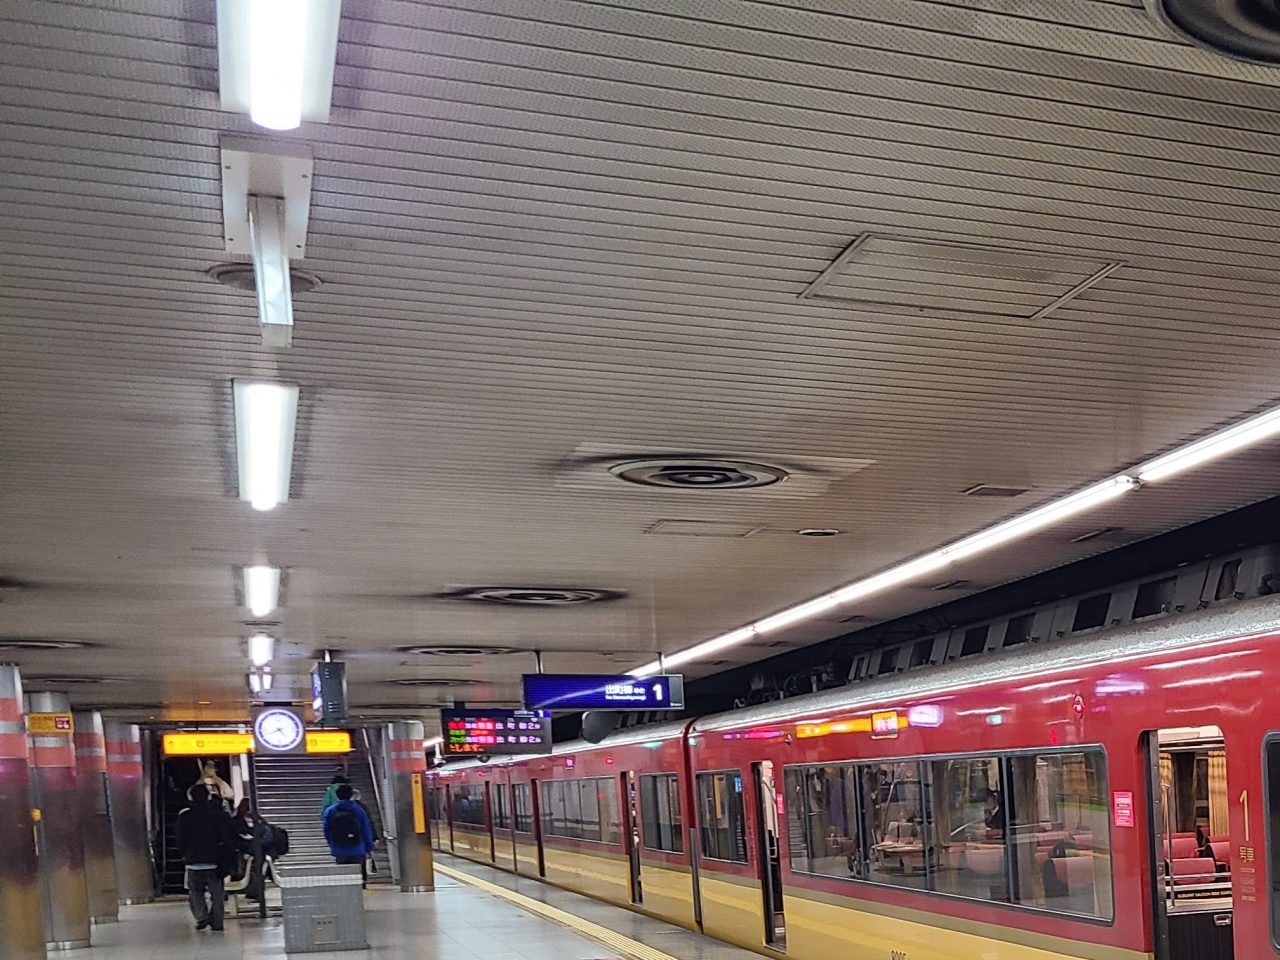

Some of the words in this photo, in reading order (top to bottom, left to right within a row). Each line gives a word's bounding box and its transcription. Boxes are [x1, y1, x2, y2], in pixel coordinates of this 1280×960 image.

[652, 684, 663, 700] 1
[1239, 789, 1250, 842] 1
[1240, 847, 1255, 863] 号車
